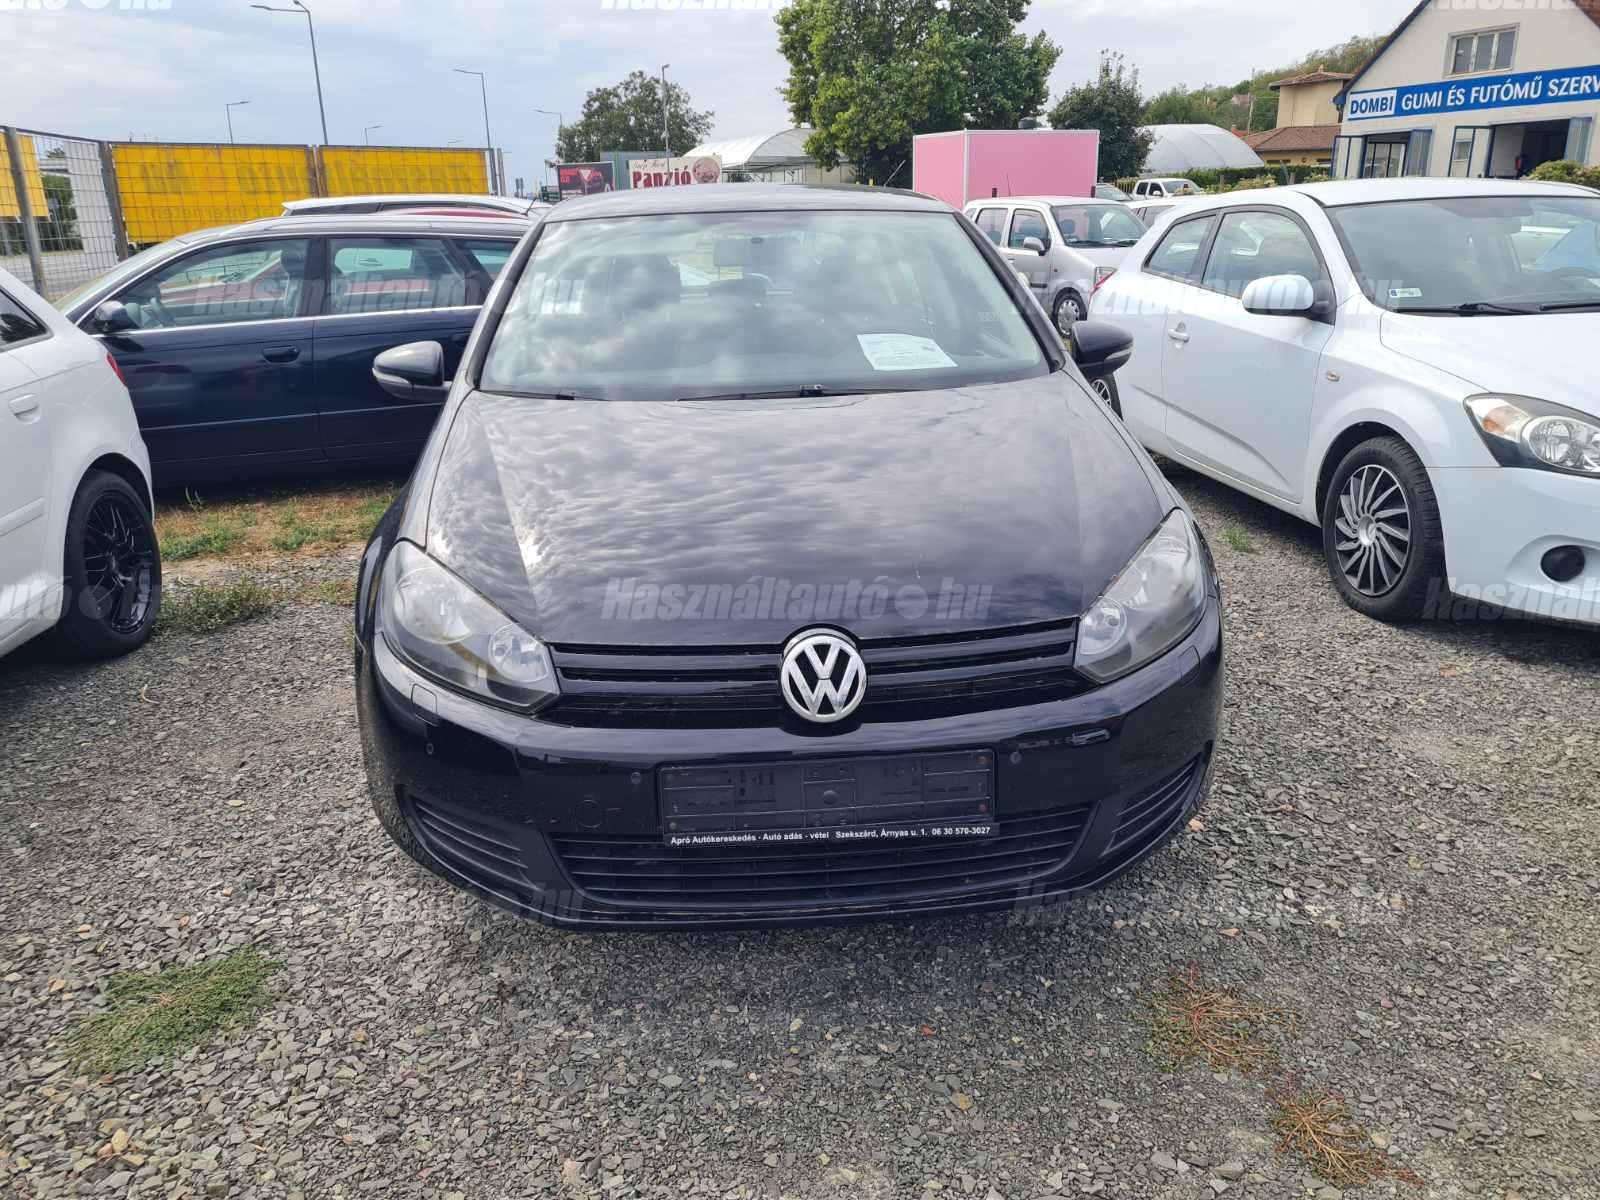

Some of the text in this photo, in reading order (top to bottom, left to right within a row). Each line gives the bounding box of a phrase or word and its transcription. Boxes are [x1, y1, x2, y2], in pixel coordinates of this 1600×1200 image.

[1350, 95, 1394, 115] DOMBI
[1401, 93, 1442, 110] GUMI
[1446, 86, 1465, 106] ÉS
[1470, 76, 1543, 105] FUTÓMŰ
[632, 165, 692, 189] Panzió
[670, 836, 691, 845] Apró
[691, 834, 757, 844] Autókereskedés
[762, 833, 783, 841] Autó
[783, 832, 803, 841] adás
[809, 831, 830, 840] vétel
[835, 830, 879, 839] Szekszárd,
[880, 828, 909, 839] Árnyas
[943, 827, 953, 835] 30
